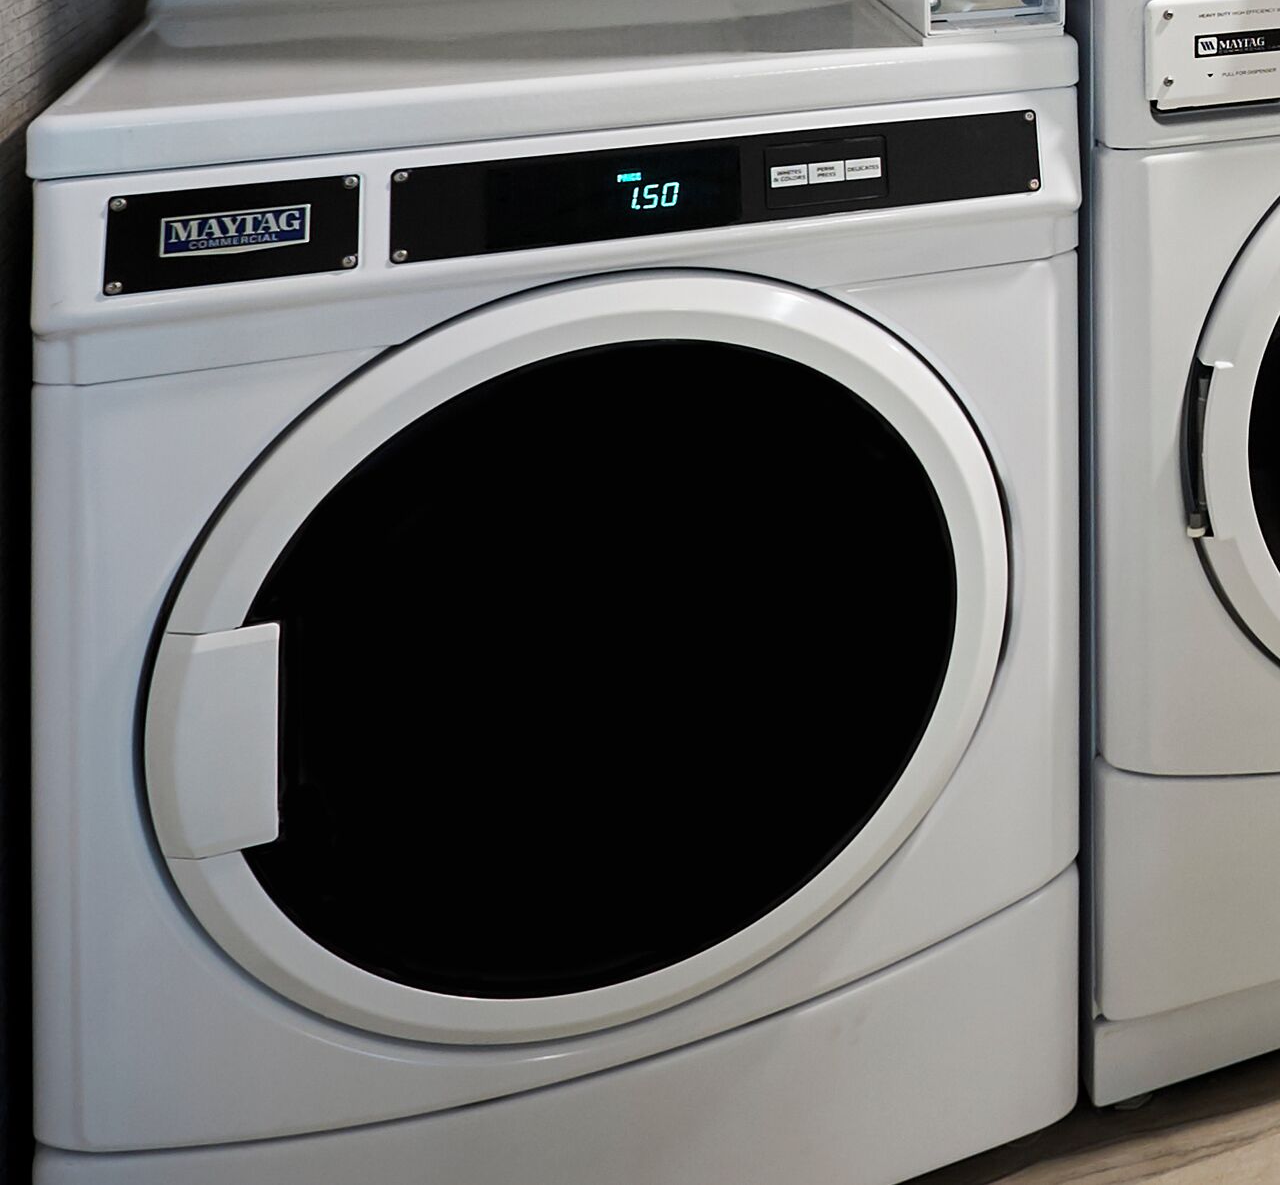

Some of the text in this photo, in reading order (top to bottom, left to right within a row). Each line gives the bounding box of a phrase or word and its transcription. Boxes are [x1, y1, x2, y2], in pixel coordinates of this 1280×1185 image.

[1219, 36, 1266, 51] MAYTAG
[631, 182, 680, 210] 1.50
[168, 210, 302, 243] MAYTAG
[188, 233, 279, 250] COMMERCIAL
